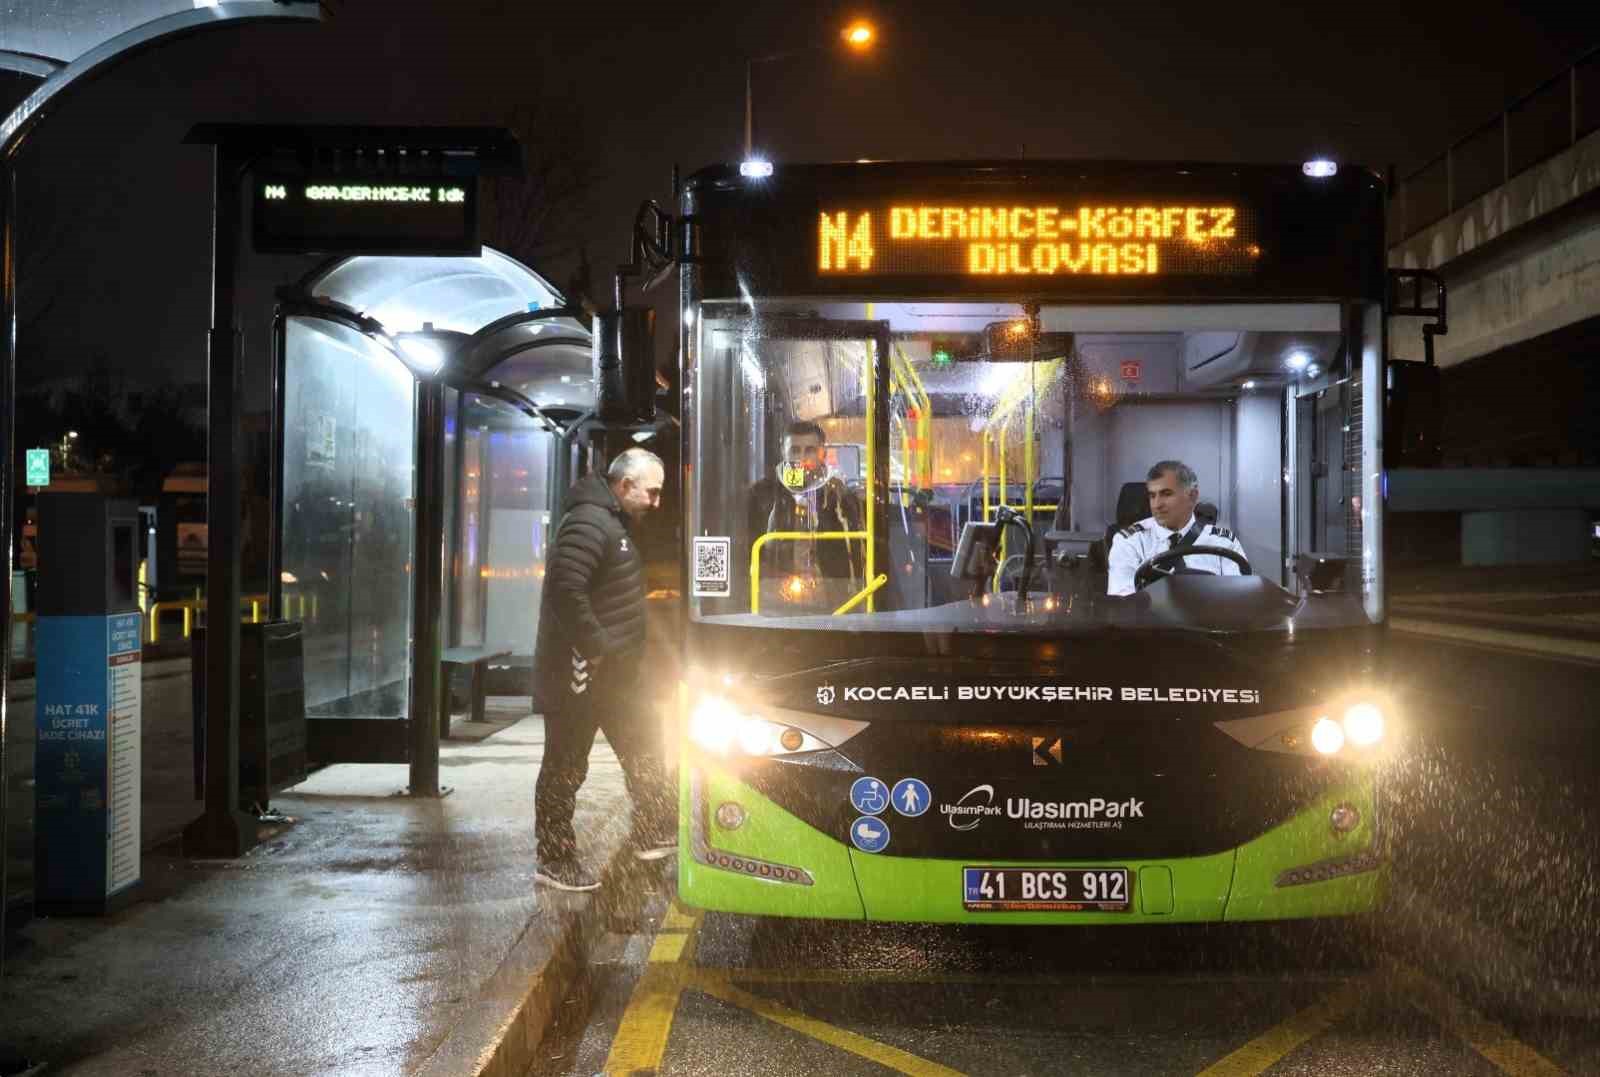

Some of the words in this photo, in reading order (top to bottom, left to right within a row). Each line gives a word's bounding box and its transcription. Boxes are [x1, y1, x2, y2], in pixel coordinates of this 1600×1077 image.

[265, 186, 286, 198] N4
[819, 211, 874, 271] N4
[45, 704, 72, 716] HAT
[980, 872, 1005, 899] 41
[1021, 872, 1067, 899] BCS
[1083, 872, 1124, 899] 912
